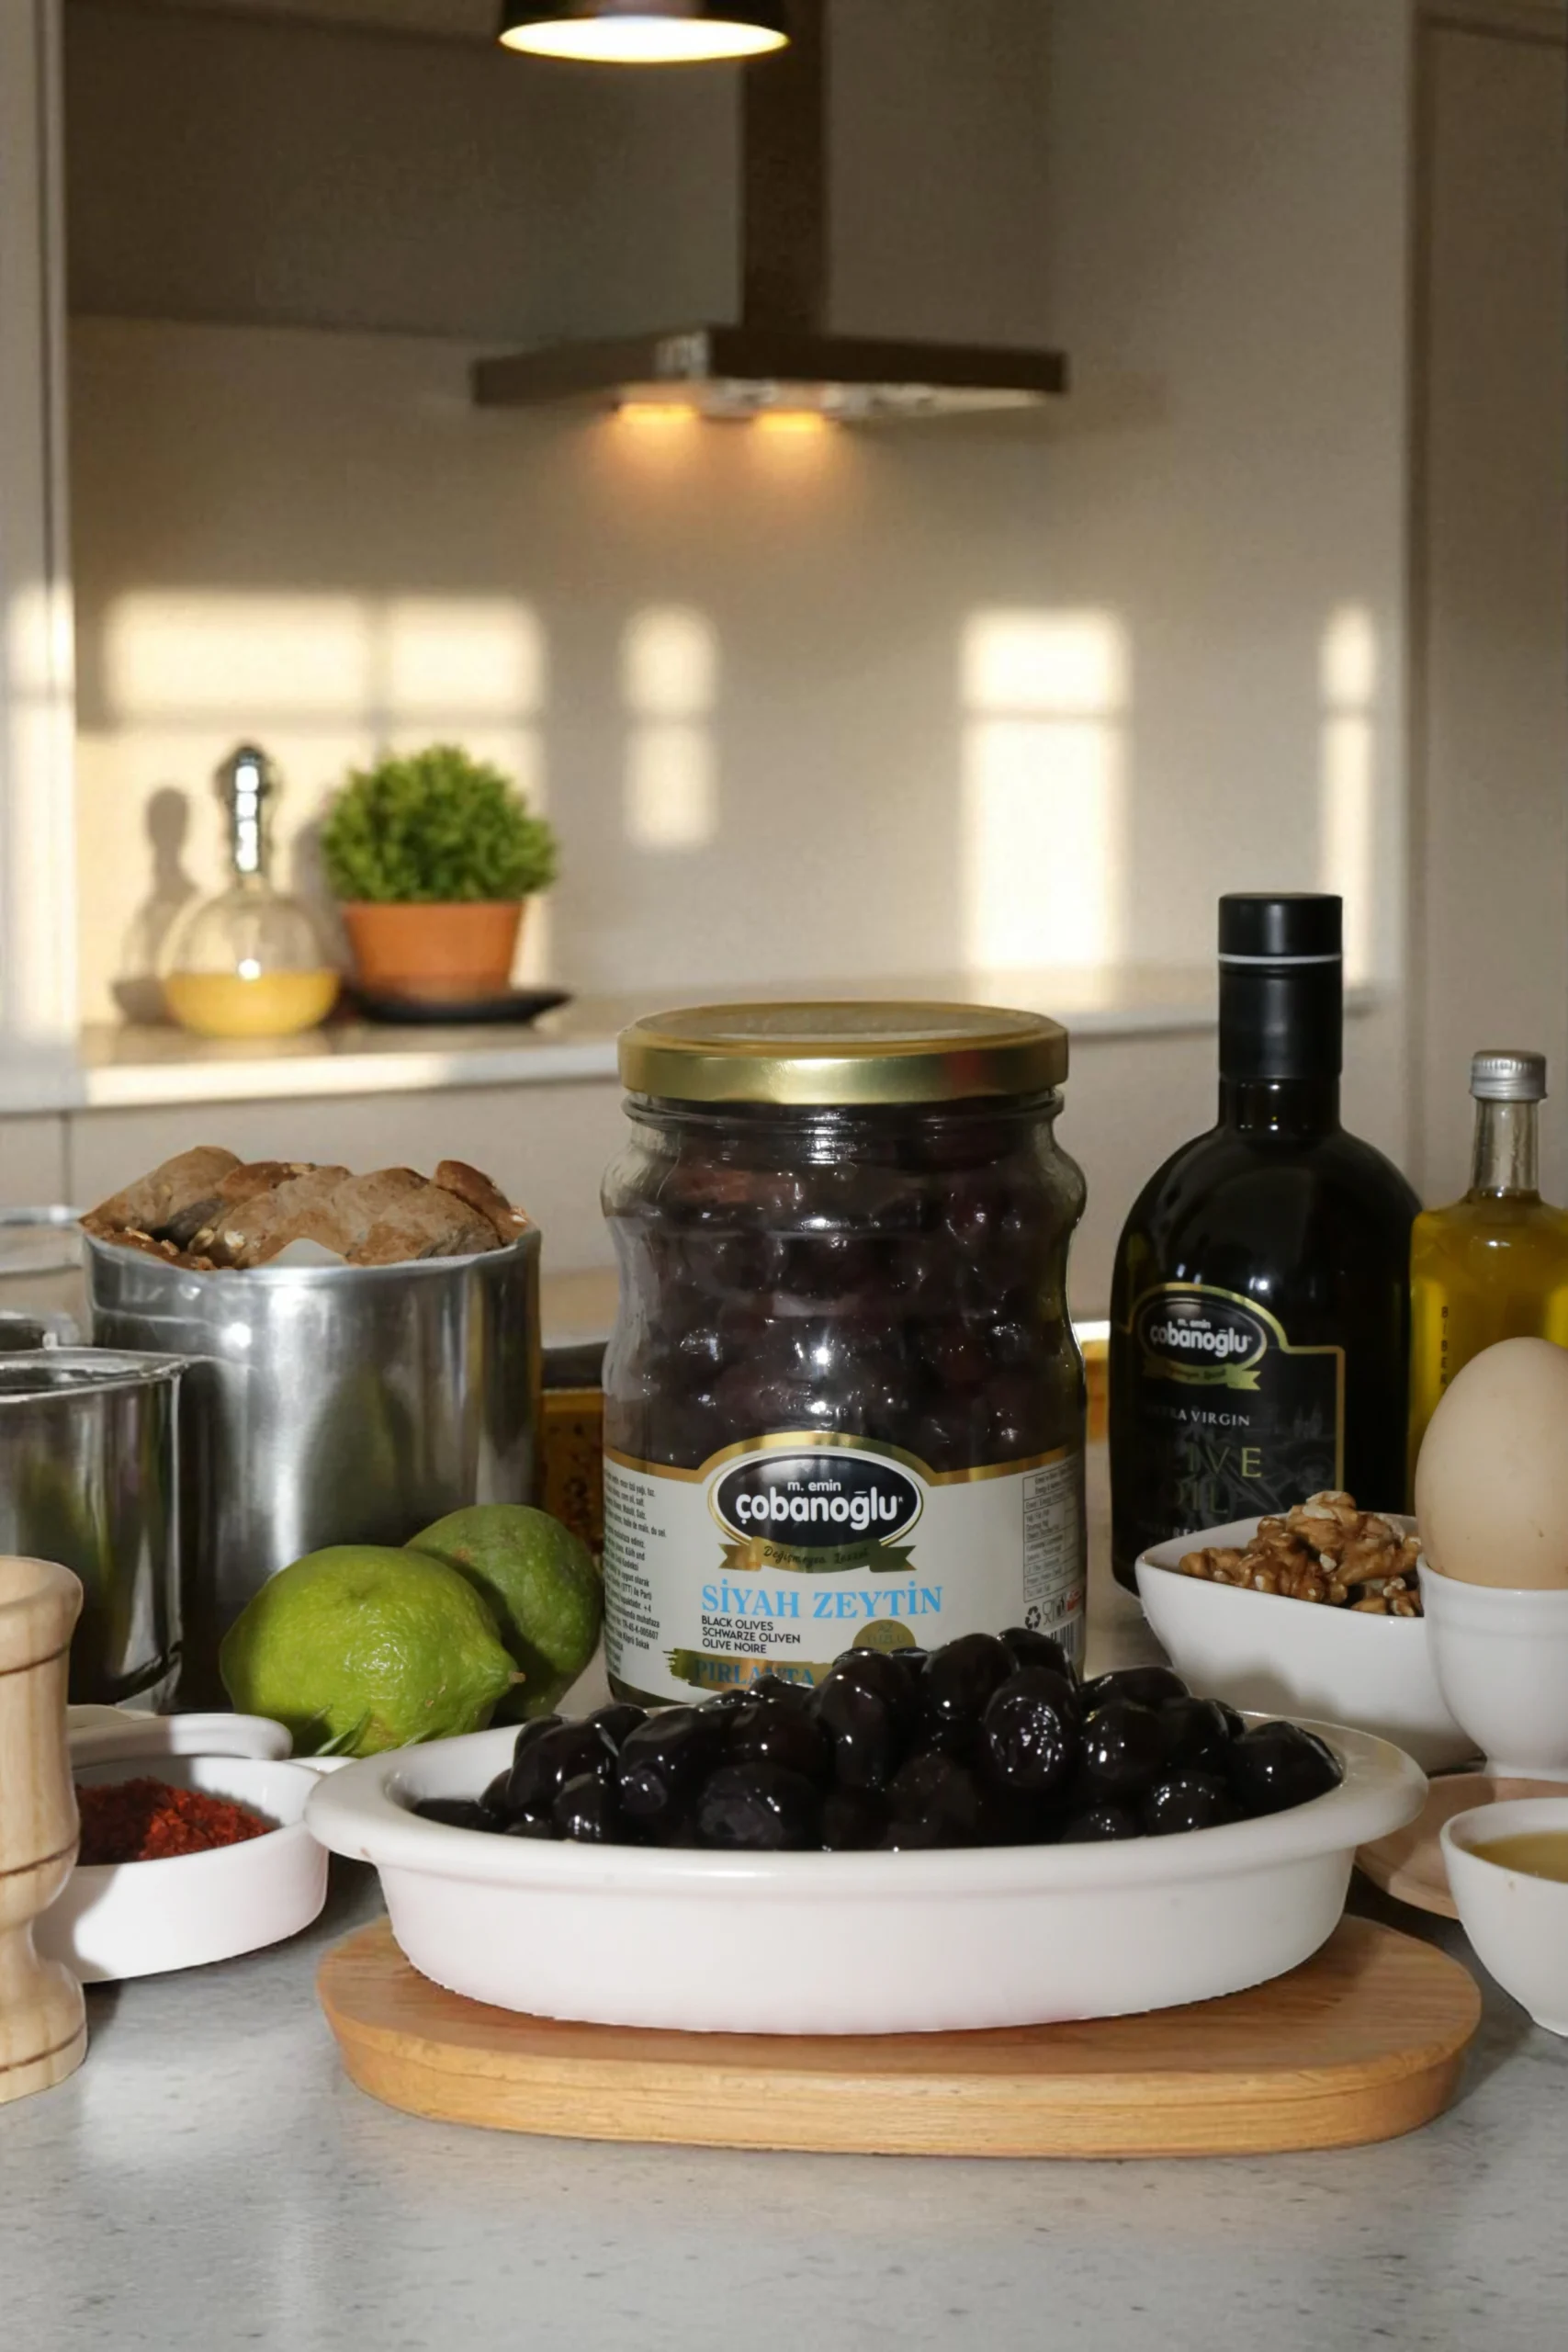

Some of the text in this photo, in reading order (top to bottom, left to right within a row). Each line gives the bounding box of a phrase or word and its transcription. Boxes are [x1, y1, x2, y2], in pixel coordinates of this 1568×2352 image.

[1150, 1321, 1247, 1358] çobanoğlu
[1190, 1408, 1251, 1427] VIRGIN
[787, 1478, 842, 1492] m. emin
[736, 1486, 897, 1531] çobanoğlu
[701, 1578, 943, 1619] SİYAH ZEYTİN
[701, 1614, 774, 1632] BLACK OLIVES
[702, 1627, 802, 1644] SCHWARZE OLIVEN
[702, 1639, 767, 1654] OLIVE NOIRE
